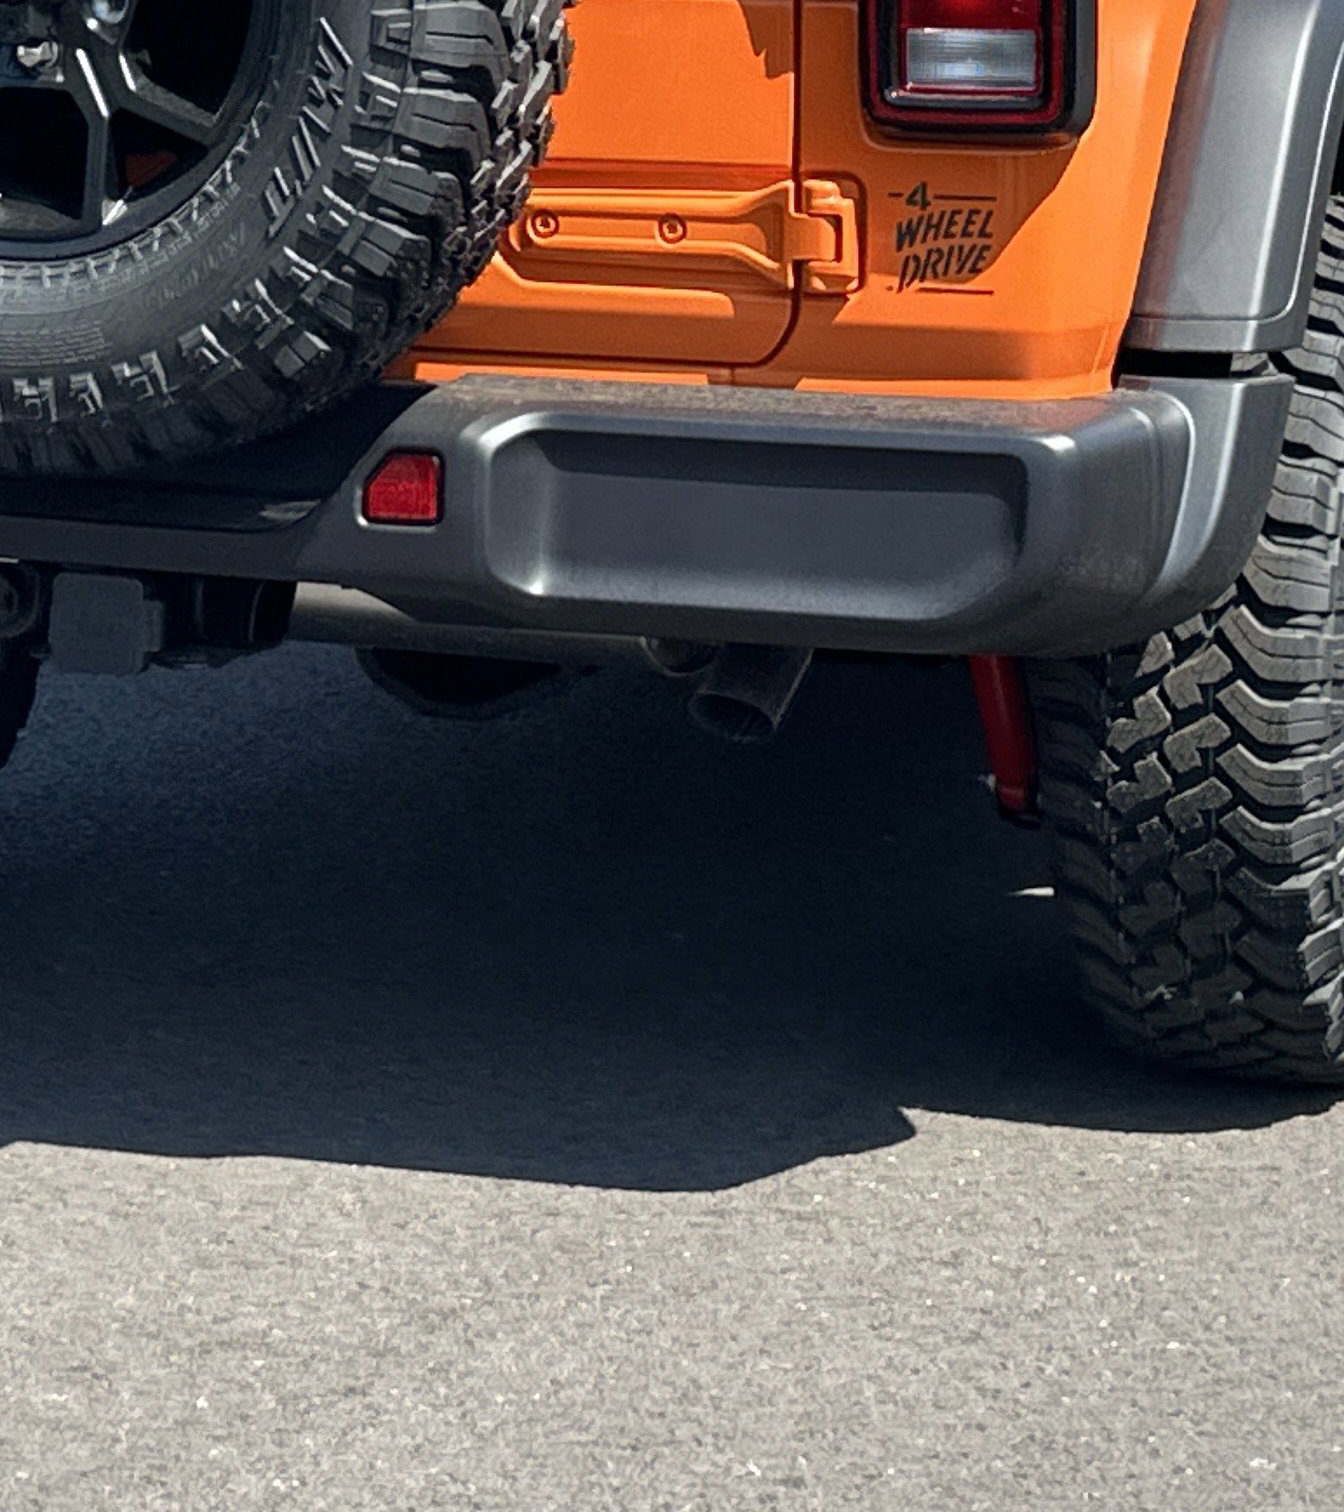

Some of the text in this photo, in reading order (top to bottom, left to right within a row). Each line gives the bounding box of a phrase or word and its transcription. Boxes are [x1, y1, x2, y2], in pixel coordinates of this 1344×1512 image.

[905, 181, 931, 210] 4
[895, 209, 994, 253] WHEEL
[896, 244, 992, 294] DRIVE
